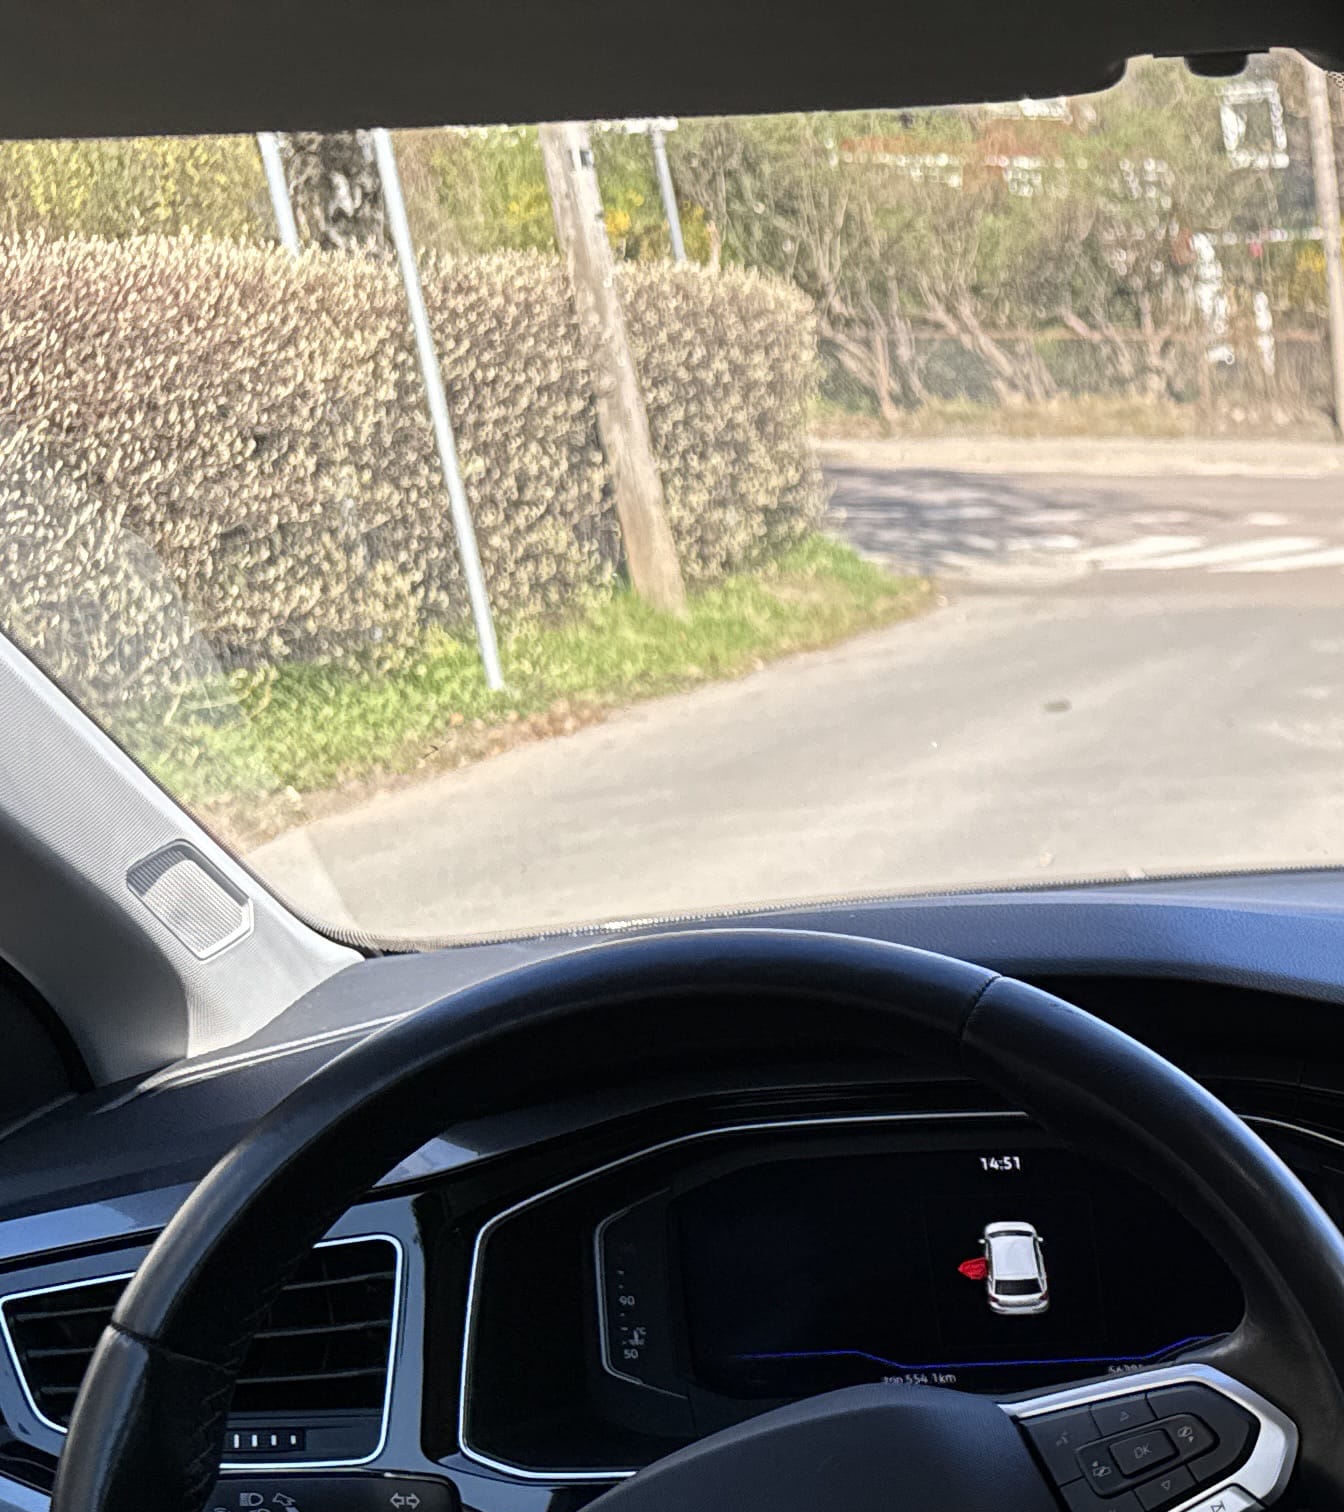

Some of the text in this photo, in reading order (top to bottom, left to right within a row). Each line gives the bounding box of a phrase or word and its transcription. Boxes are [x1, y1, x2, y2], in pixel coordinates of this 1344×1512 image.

[978, 1155, 1021, 1172] 14:51
[617, 1295, 636, 1307] 90
[623, 1348, 639, 1360] 50
[1133, 1442, 1153, 1459] OK
